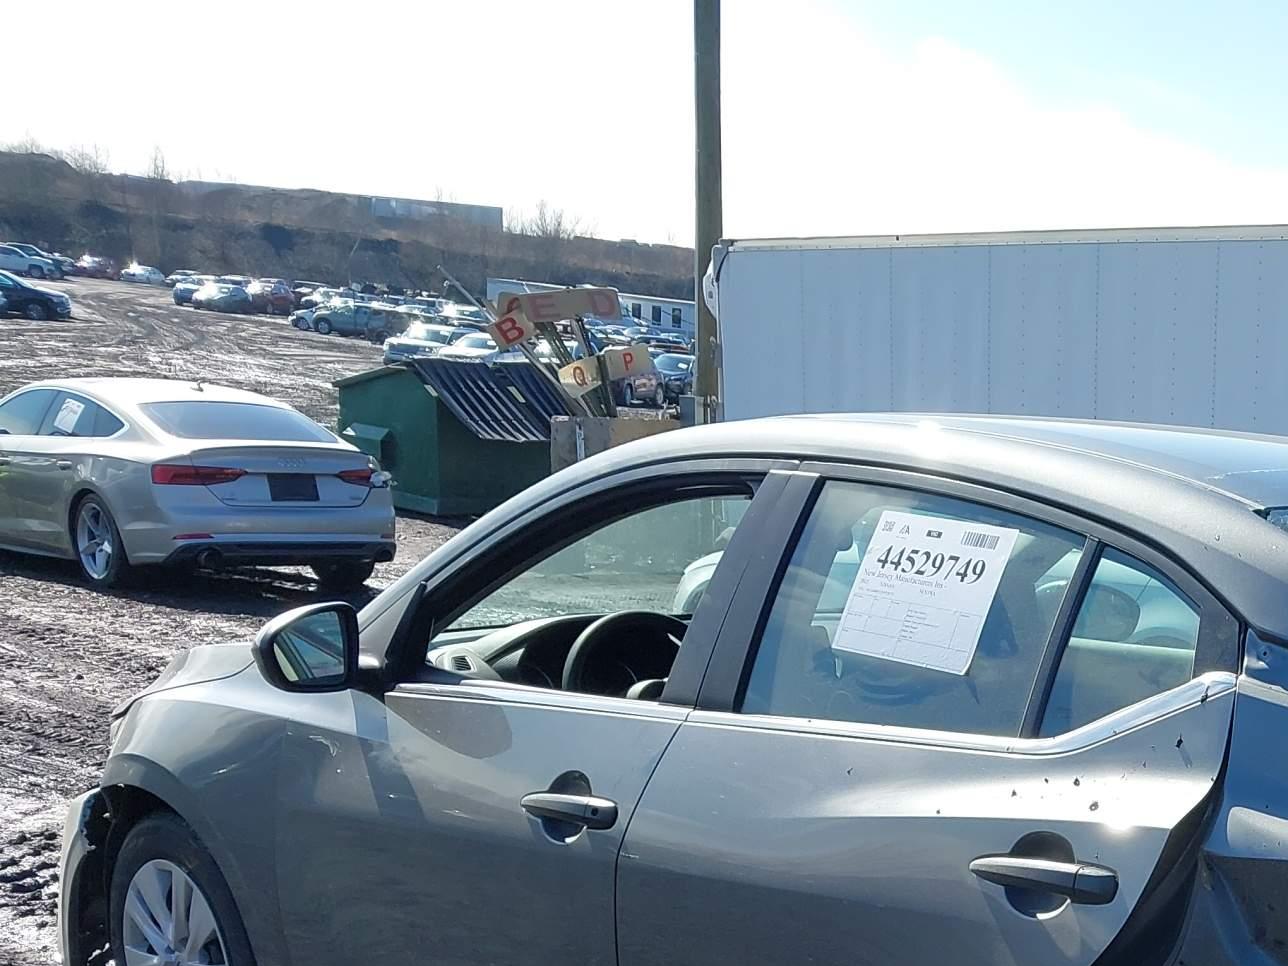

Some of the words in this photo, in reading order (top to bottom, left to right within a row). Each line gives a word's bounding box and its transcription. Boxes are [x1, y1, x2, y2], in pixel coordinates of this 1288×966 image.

[495, 317, 525, 345] B
[622, 352, 633, 371] P
[573, 366, 588, 387] Q
[876, 545, 986, 585] 44529749
